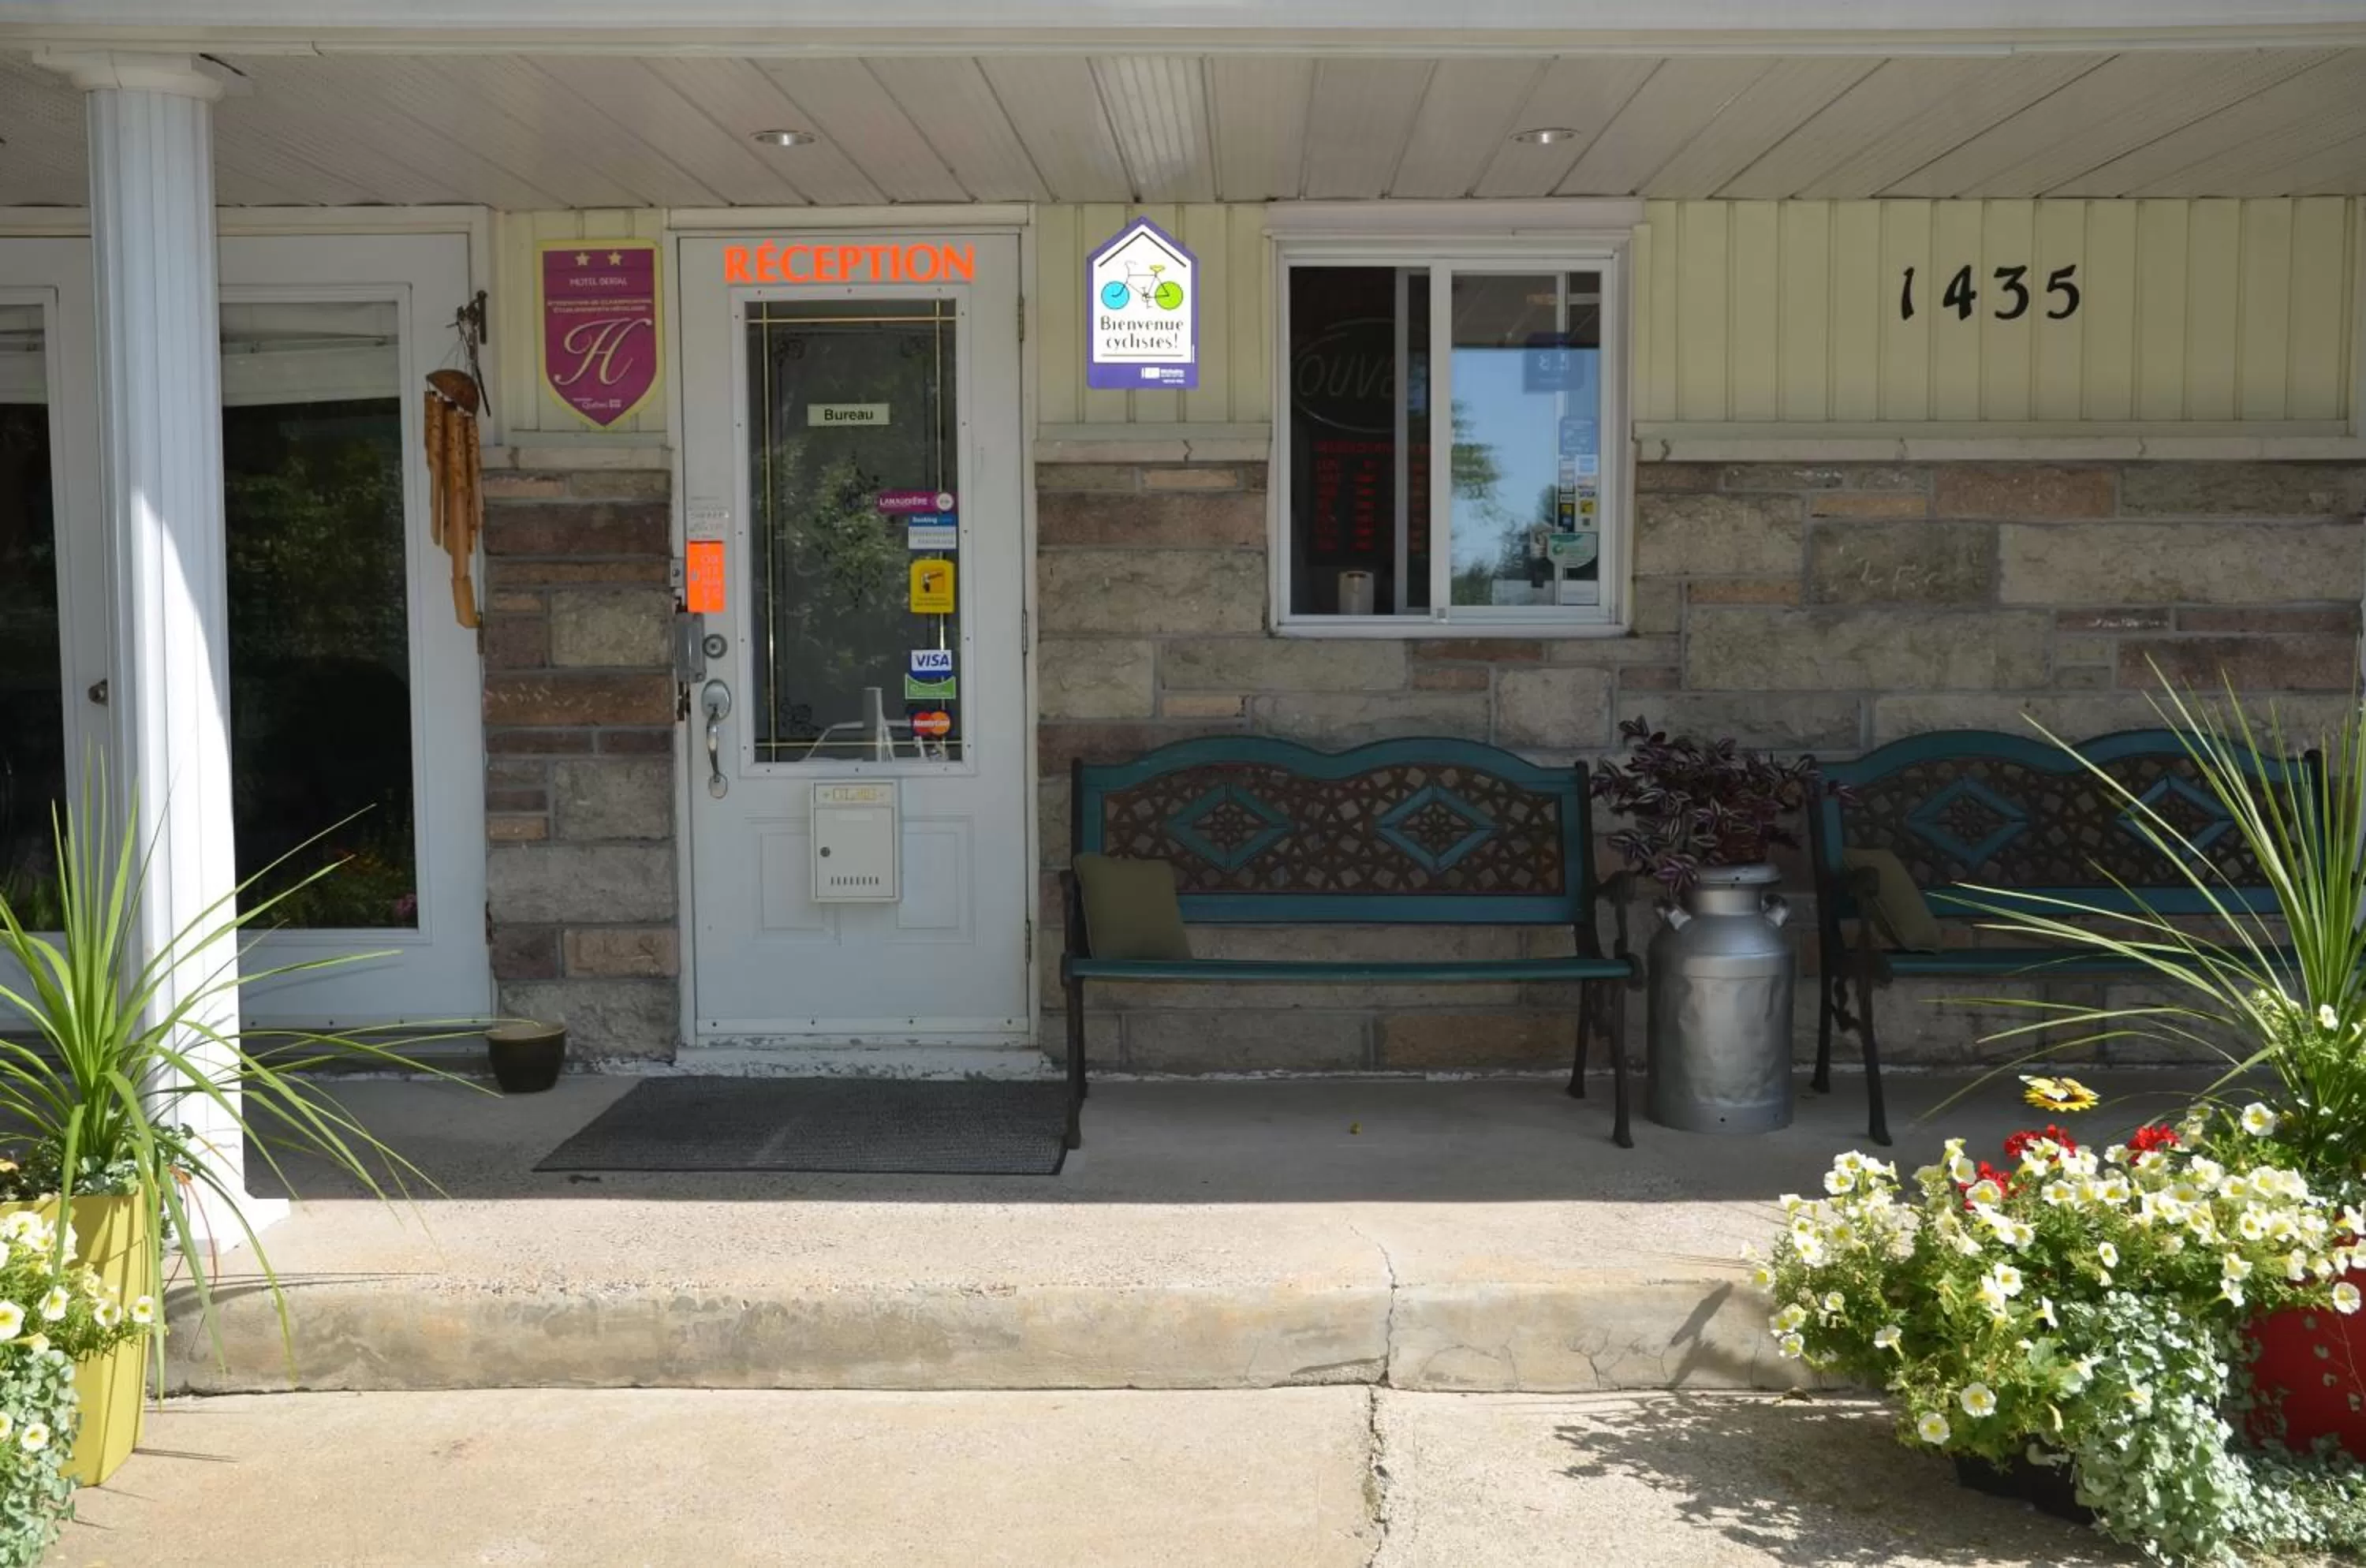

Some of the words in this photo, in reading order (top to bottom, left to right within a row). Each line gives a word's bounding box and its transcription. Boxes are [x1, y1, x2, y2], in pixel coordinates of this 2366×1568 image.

[725, 240, 975, 282] RÉCEPTION
[1901, 265, 2080, 320] 1435
[1101, 315, 1184, 330] Bienvenue
[554, 318, 652, 386] H
[1106, 332, 1177, 353] cyclistes!
[824, 409, 874, 420] Bureau
[916, 654, 950, 666] VISA
